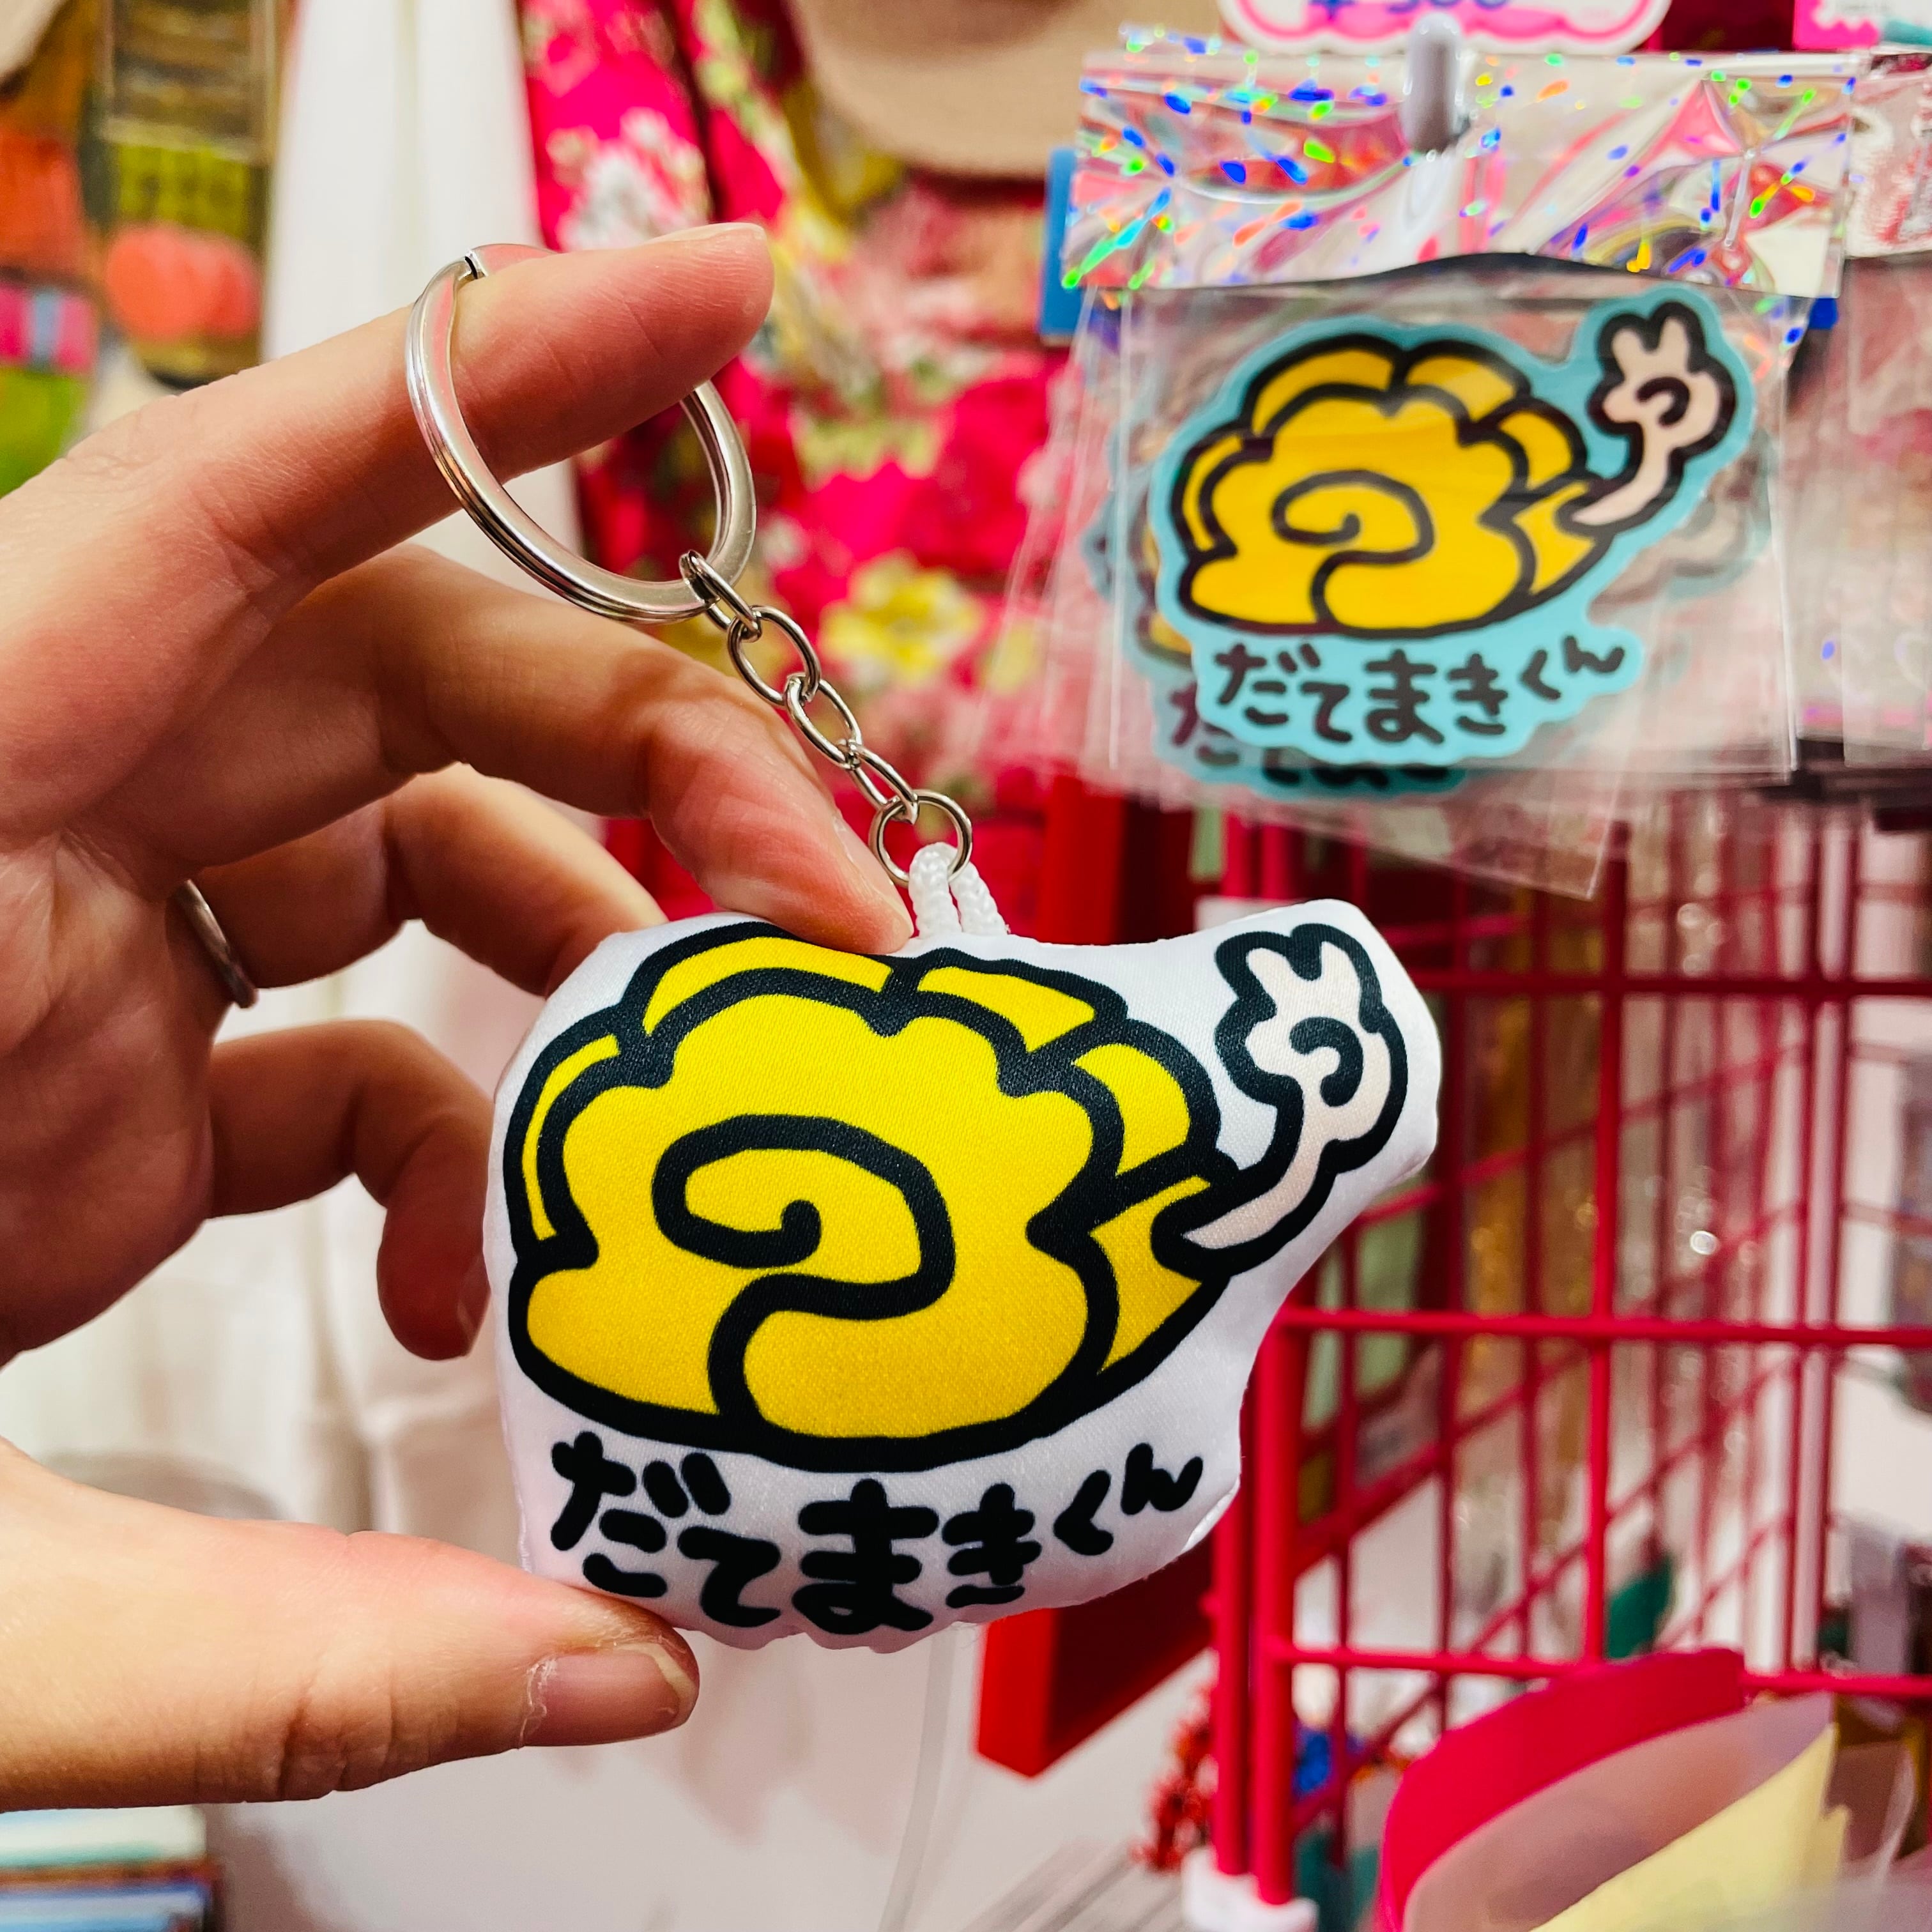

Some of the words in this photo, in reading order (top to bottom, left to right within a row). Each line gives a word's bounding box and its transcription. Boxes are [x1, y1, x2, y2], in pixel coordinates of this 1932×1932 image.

[1215, 636, 1625, 744] だてまきくん
[551, 1431, 1202, 1634] だてまきくん
